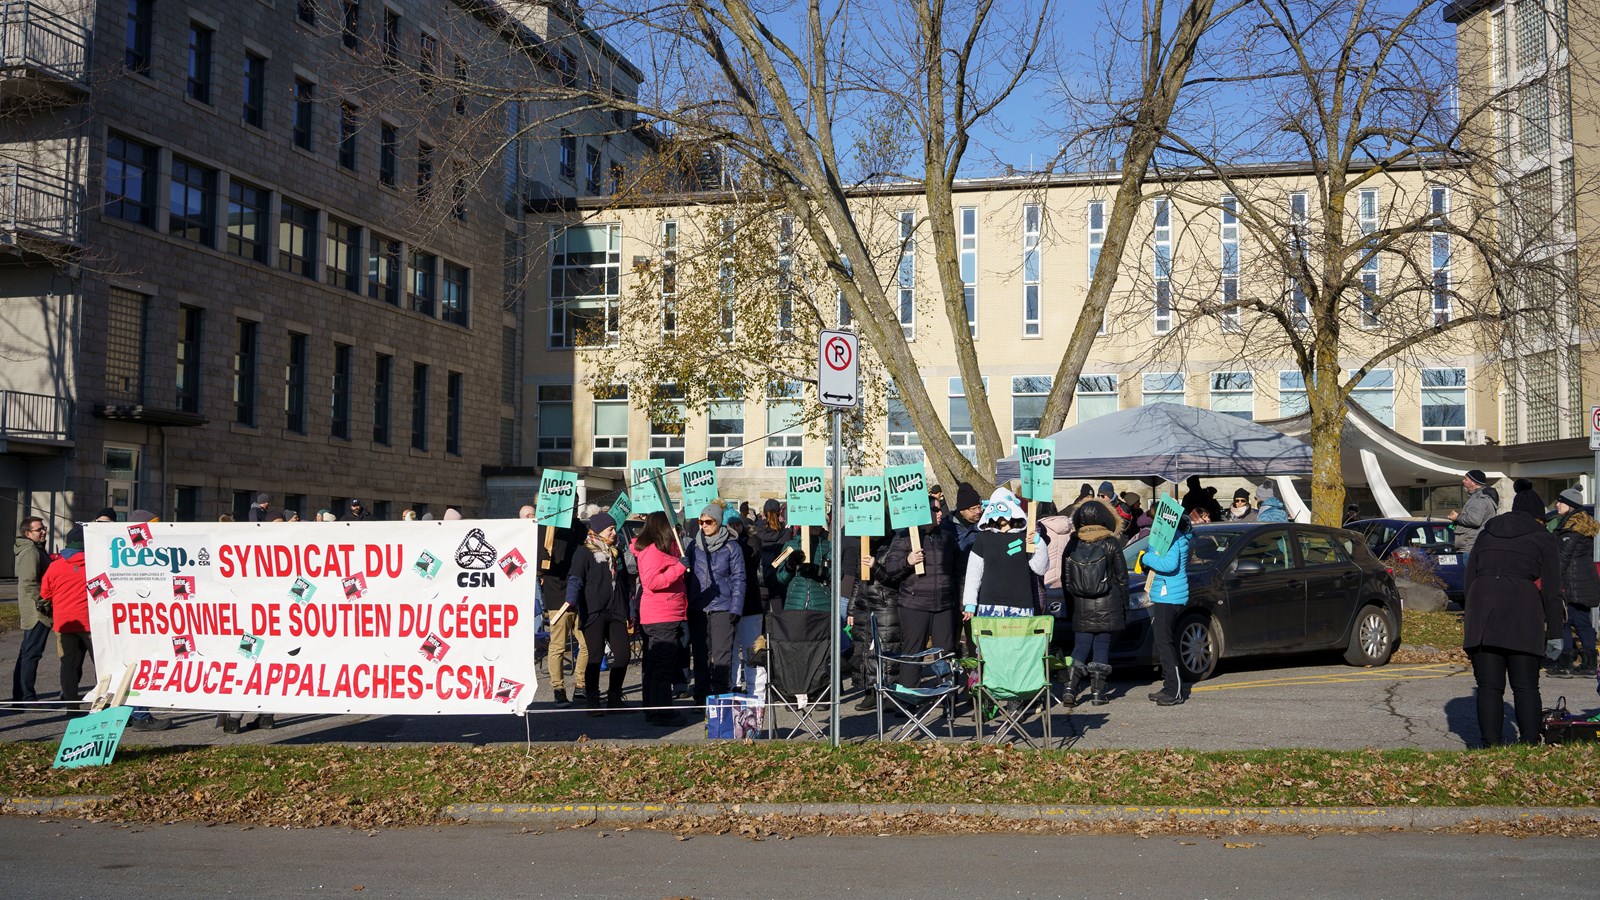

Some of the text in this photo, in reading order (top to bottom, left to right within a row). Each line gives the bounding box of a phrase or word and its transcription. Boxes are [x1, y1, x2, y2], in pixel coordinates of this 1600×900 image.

[835, 345, 845, 362] P
[1021, 446, 1052, 467] NOUS
[542, 477, 573, 496] NOUS
[683, 469, 714, 487] NOUS
[789, 476, 821, 493] NOUS
[888, 472, 924, 494] NOUS
[848, 485, 881, 502] NOUS
[1158, 501, 1179, 528] NOUS
[109, 537, 195, 574] feesp.
[219, 544, 404, 578] SYNDICAT DU
[456, 572, 495, 588] CSN
[112, 596, 519, 639] PERSONNEL DE SOUTIEN DU CÉGEP
[133, 660, 495, 701] BEAUCE-APPALACHES-CSN
[60, 740, 103, 763] NOUS
